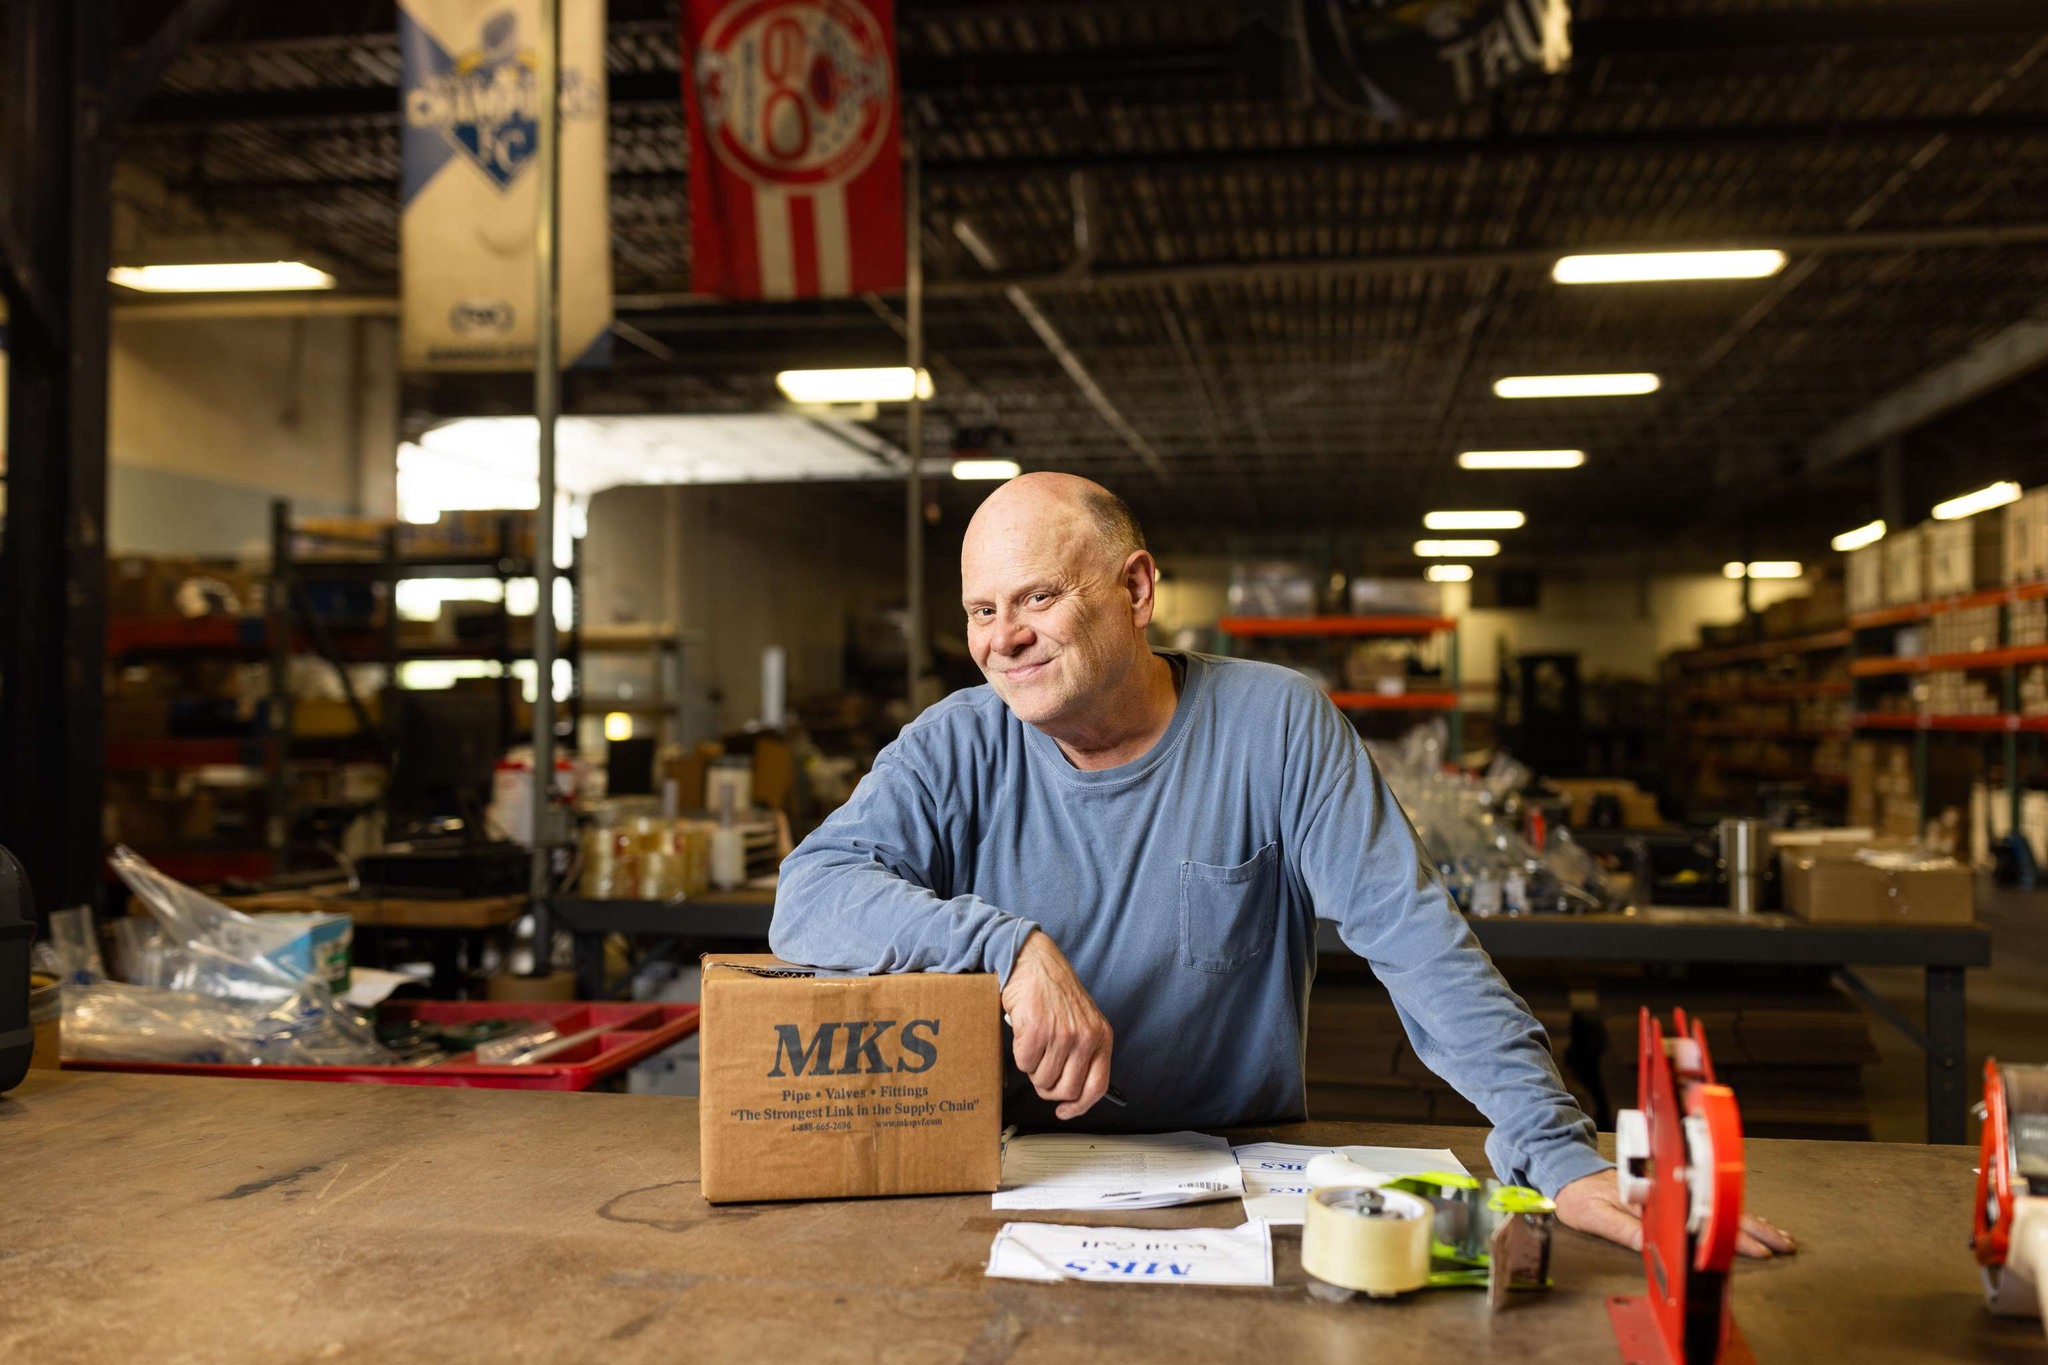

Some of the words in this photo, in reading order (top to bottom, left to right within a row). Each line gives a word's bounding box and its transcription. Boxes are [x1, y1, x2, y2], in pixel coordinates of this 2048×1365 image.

[767, 1019, 940, 1077] MKS
[782, 1090, 811, 1104] Pipe
[825, 1088, 866, 1100] Valves
[880, 1085, 929, 1099] Fittings
[764, 1107, 822, 1121] Strongest
[825, 1105, 854, 1118] Link
[857, 1104, 869, 1116] in
[872, 1103, 891, 1115] the
[894, 1101, 936, 1116] Supply
[1064, 1258, 1194, 1275] MKS
